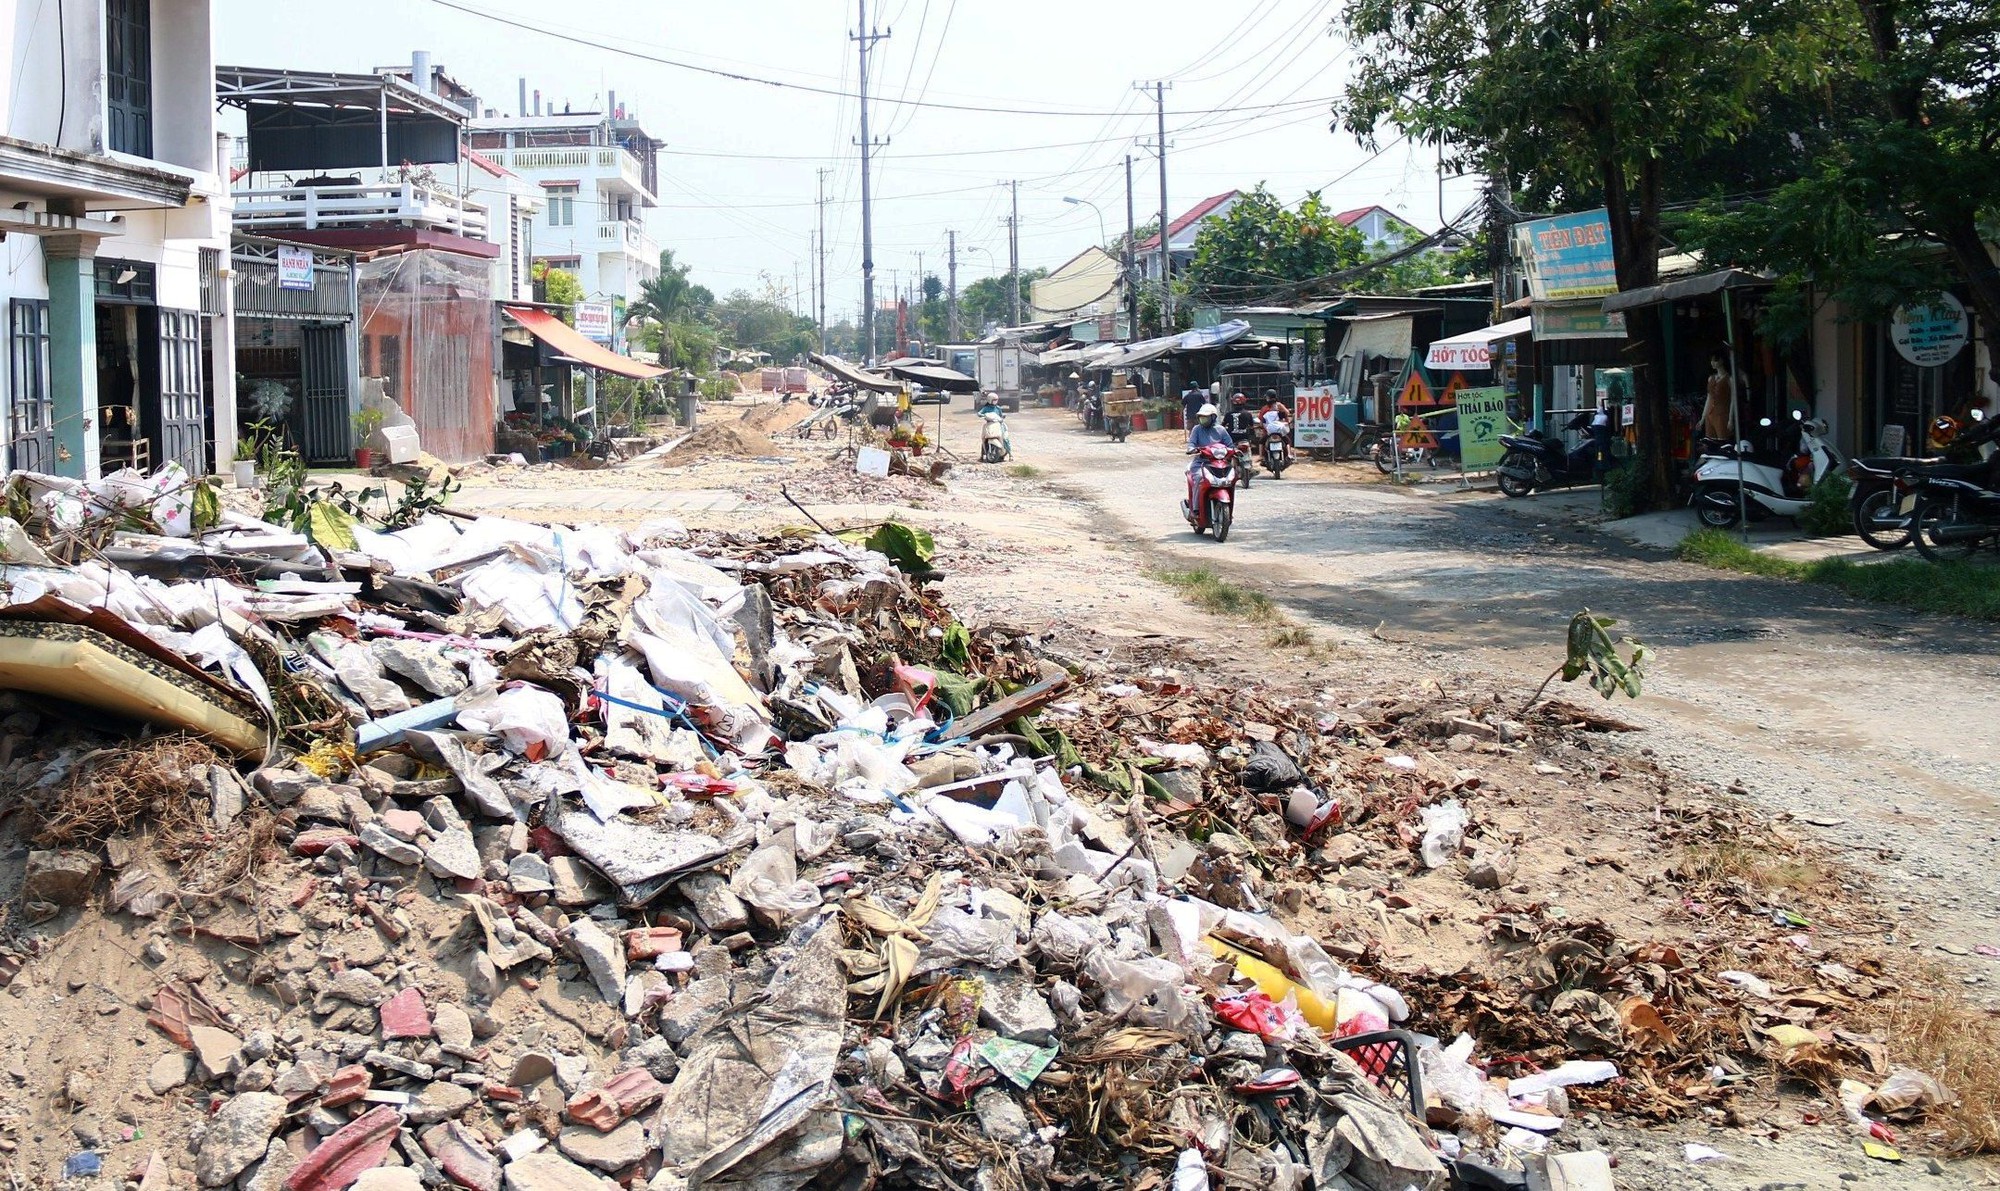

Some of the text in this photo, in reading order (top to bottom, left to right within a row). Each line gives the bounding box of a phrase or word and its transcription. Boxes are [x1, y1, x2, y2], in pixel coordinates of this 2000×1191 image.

[1430, 345, 1491, 363] HỚT TÓC
[1296, 389, 1334, 422] PHỞ
